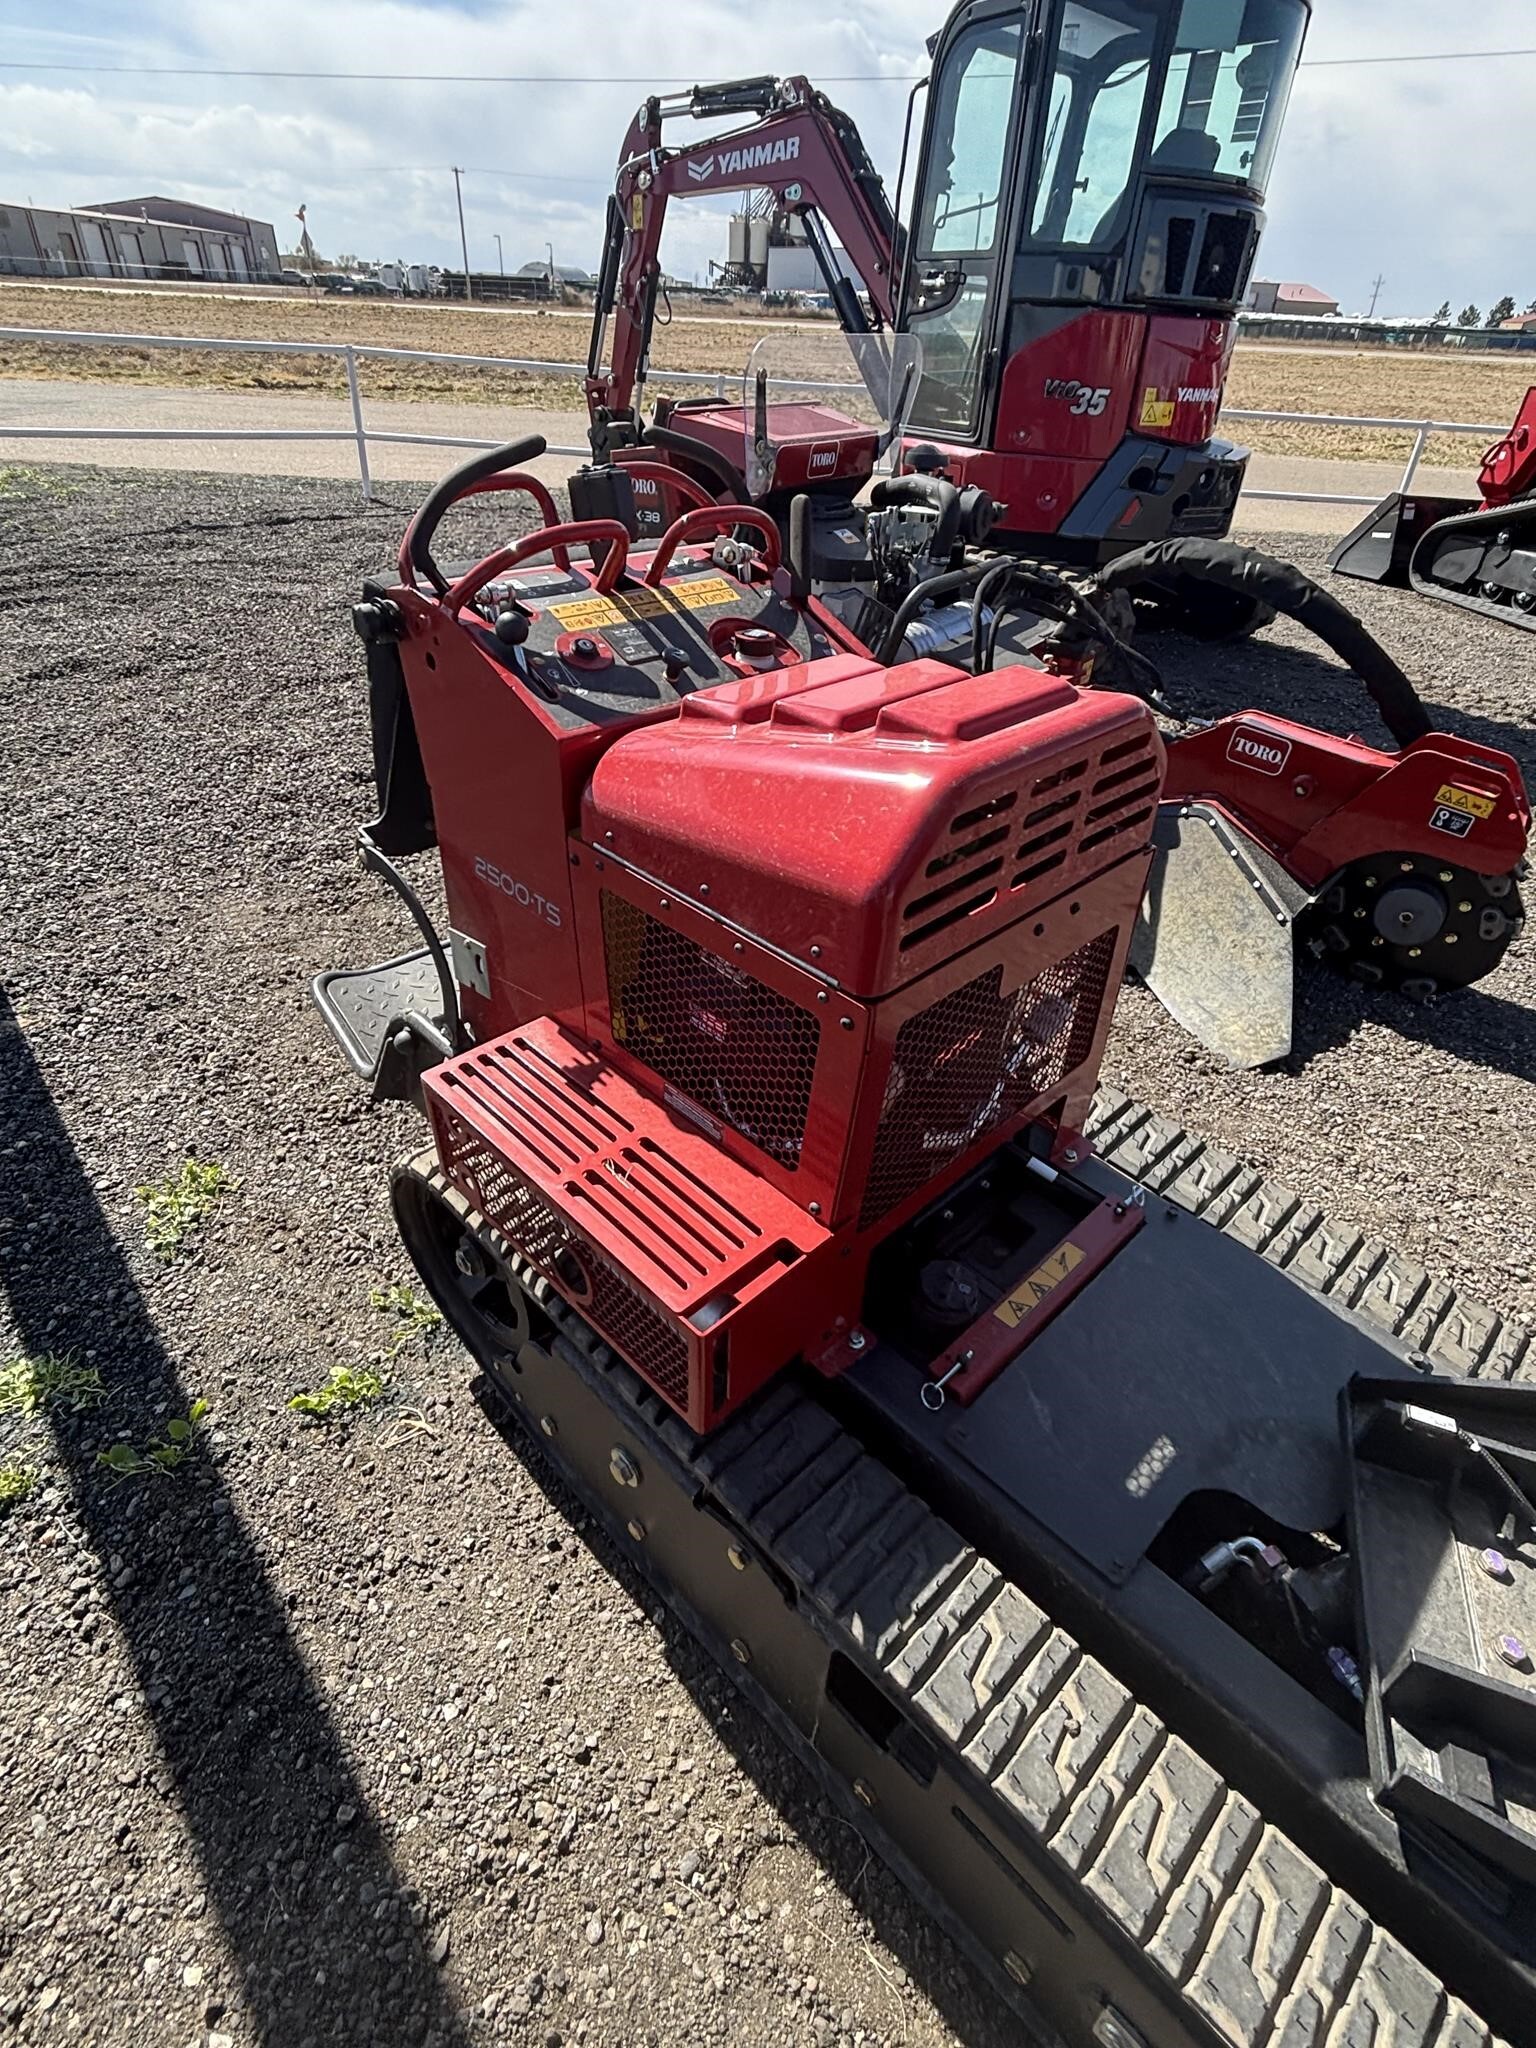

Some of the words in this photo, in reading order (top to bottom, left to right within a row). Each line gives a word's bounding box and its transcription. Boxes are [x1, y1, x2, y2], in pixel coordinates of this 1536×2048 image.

[717, 135, 800, 175] YANMAR
[1069, 386, 1111, 416] 35
[811, 451, 836, 467] TORO
[631, 477, 658, 495] ORO
[1235, 737, 1282, 764] TORO
